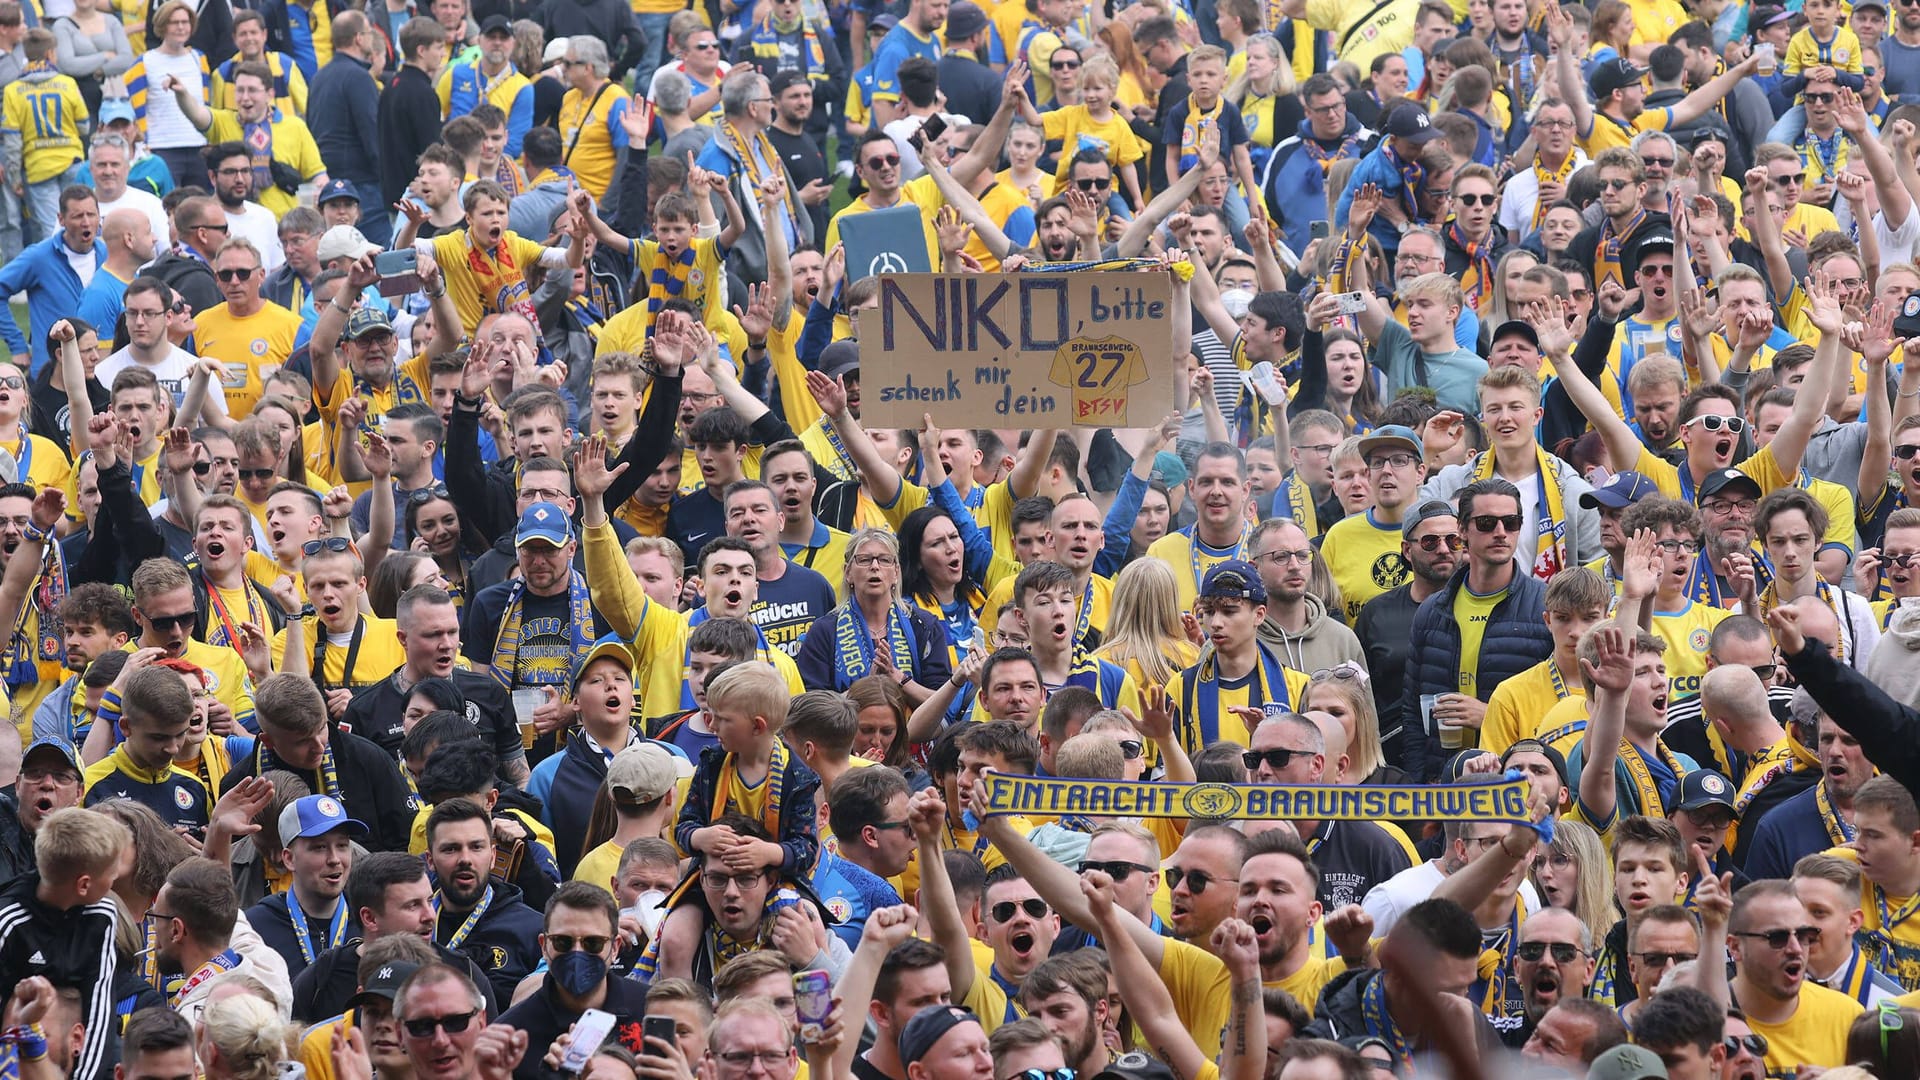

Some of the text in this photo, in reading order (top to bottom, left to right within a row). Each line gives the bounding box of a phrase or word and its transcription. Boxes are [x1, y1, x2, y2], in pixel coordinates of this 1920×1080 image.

[1376, 12, 1397, 27] 100
[26, 92, 64, 138] 10
[1090, 284, 1165, 323] bitte
[879, 356, 1012, 402] schenk mir
[1075, 352, 1125, 388] 27
[994, 384, 1057, 415] dein
[1078, 398, 1126, 417] BTSV
[573, 600, 581, 626] LIGA
[520, 645, 569, 658] BRAUNSCHWE
[991, 778, 1179, 812] EINTRACHT
[1246, 786, 1527, 817] BRAUNSCHWEIG
[1324, 872, 1366, 885] EINTRACHT
